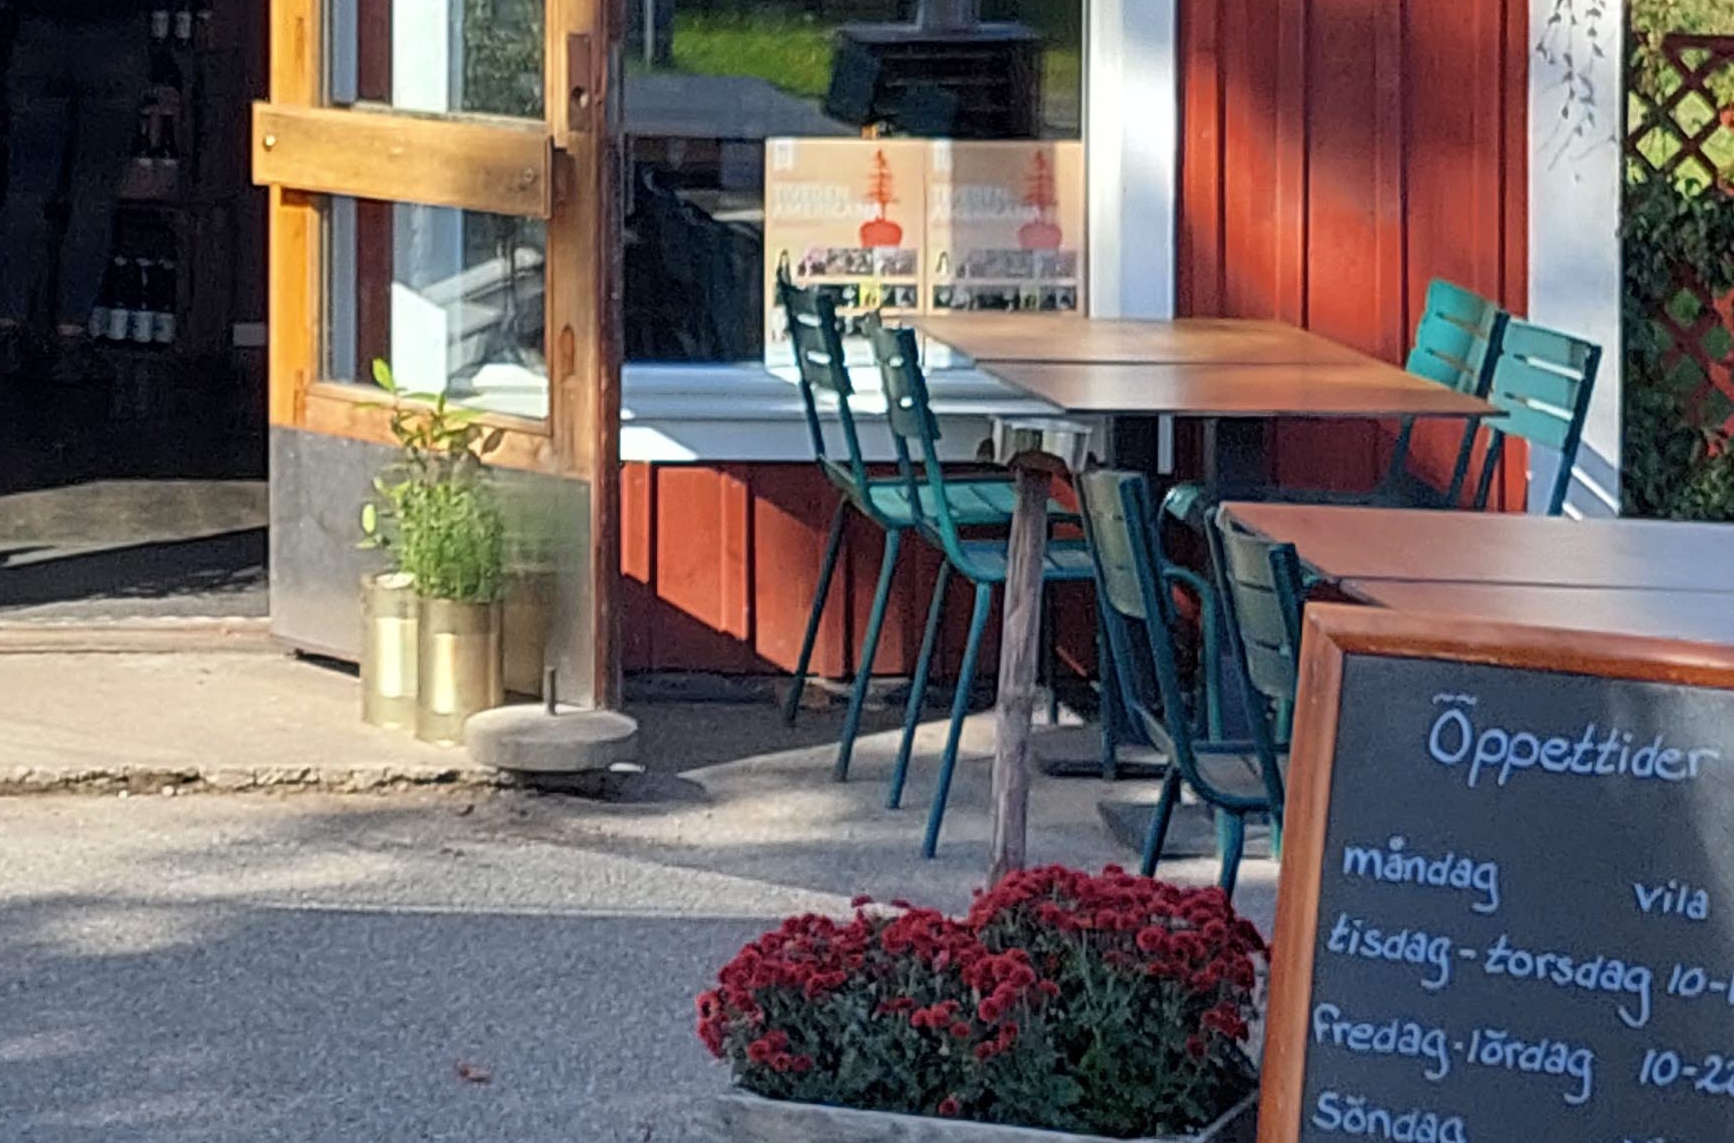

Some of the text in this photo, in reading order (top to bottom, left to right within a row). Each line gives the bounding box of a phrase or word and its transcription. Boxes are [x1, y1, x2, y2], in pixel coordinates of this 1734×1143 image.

[1428, 694, 1720, 788] Öppettider
[1342, 836, 1710, 921] måndag vila
